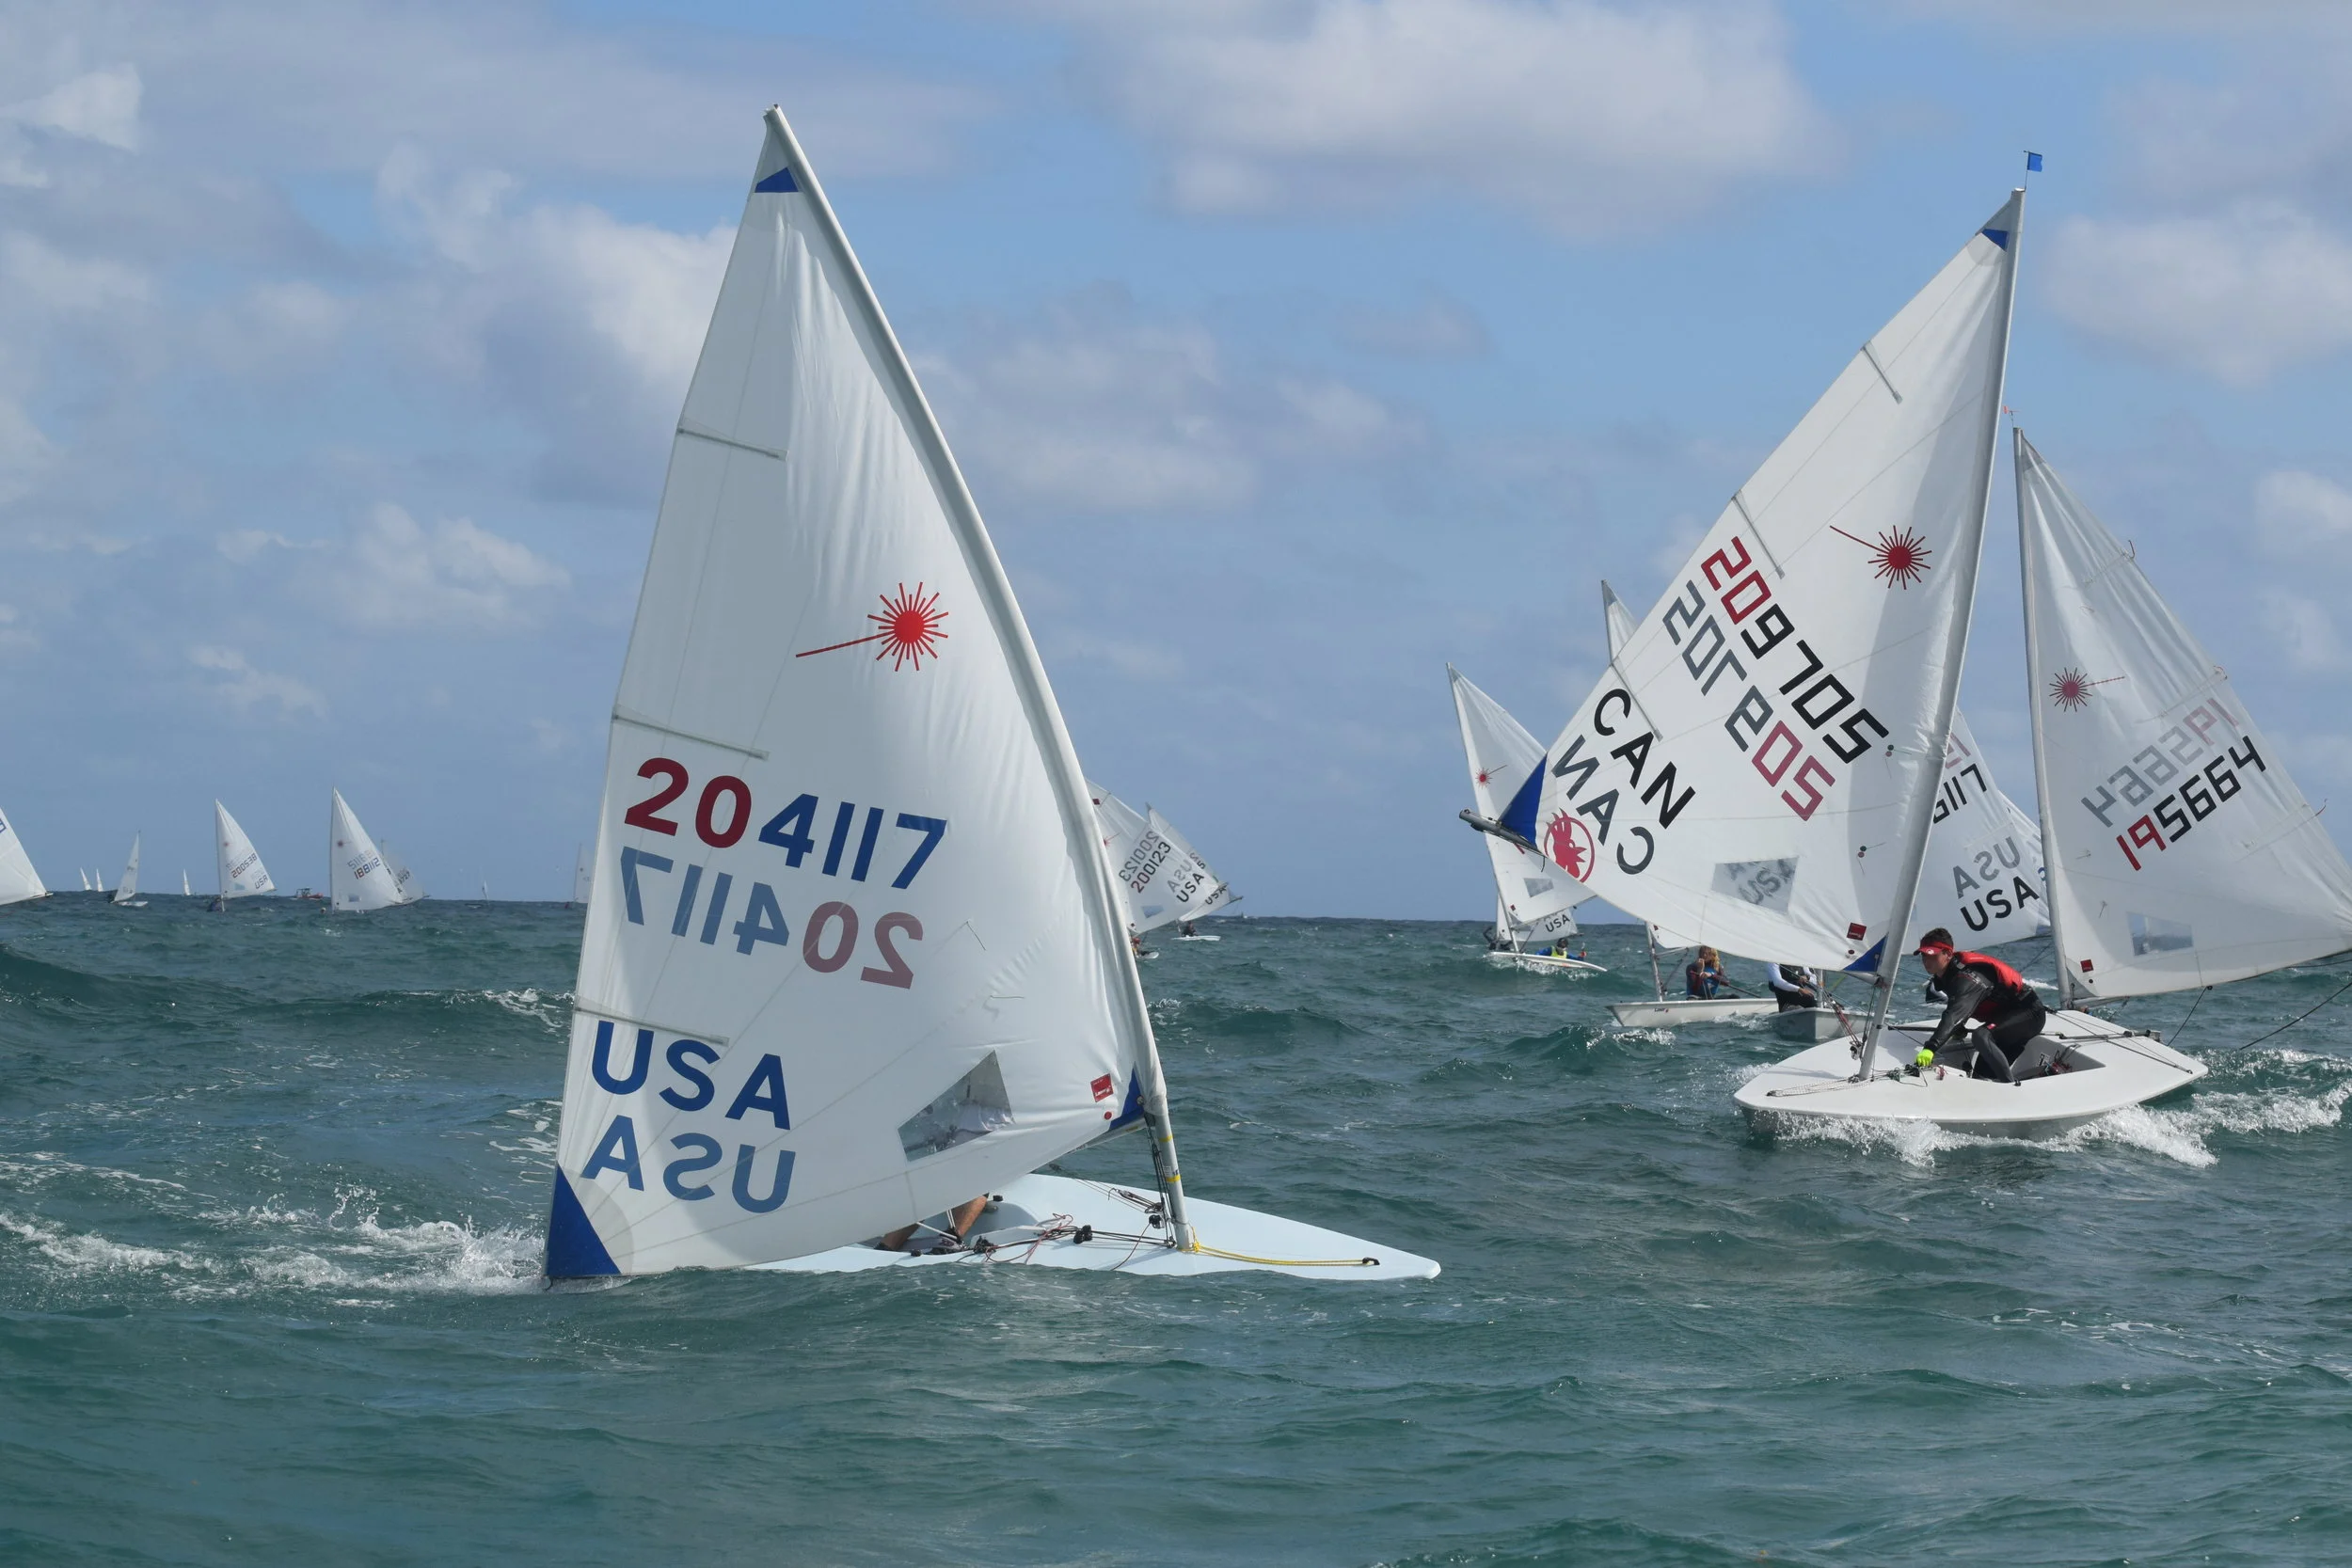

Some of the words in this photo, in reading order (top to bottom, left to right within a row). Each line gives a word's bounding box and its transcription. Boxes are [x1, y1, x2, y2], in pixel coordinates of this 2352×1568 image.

[1701, 536, 1889, 764] 209705
[1594, 689, 1695, 829] CAN
[625, 757, 946, 889] 204117
[2116, 735, 2266, 871] 195664
[254, 874, 269, 890] USA
[1131, 841, 1171, 894] 200123
[1176, 872, 1204, 903] USA
[1205, 885, 1228, 905] USA
[1545, 913, 1571, 933] USA
[1960, 875, 2040, 931] USA
[592, 1021, 791, 1131] USA
